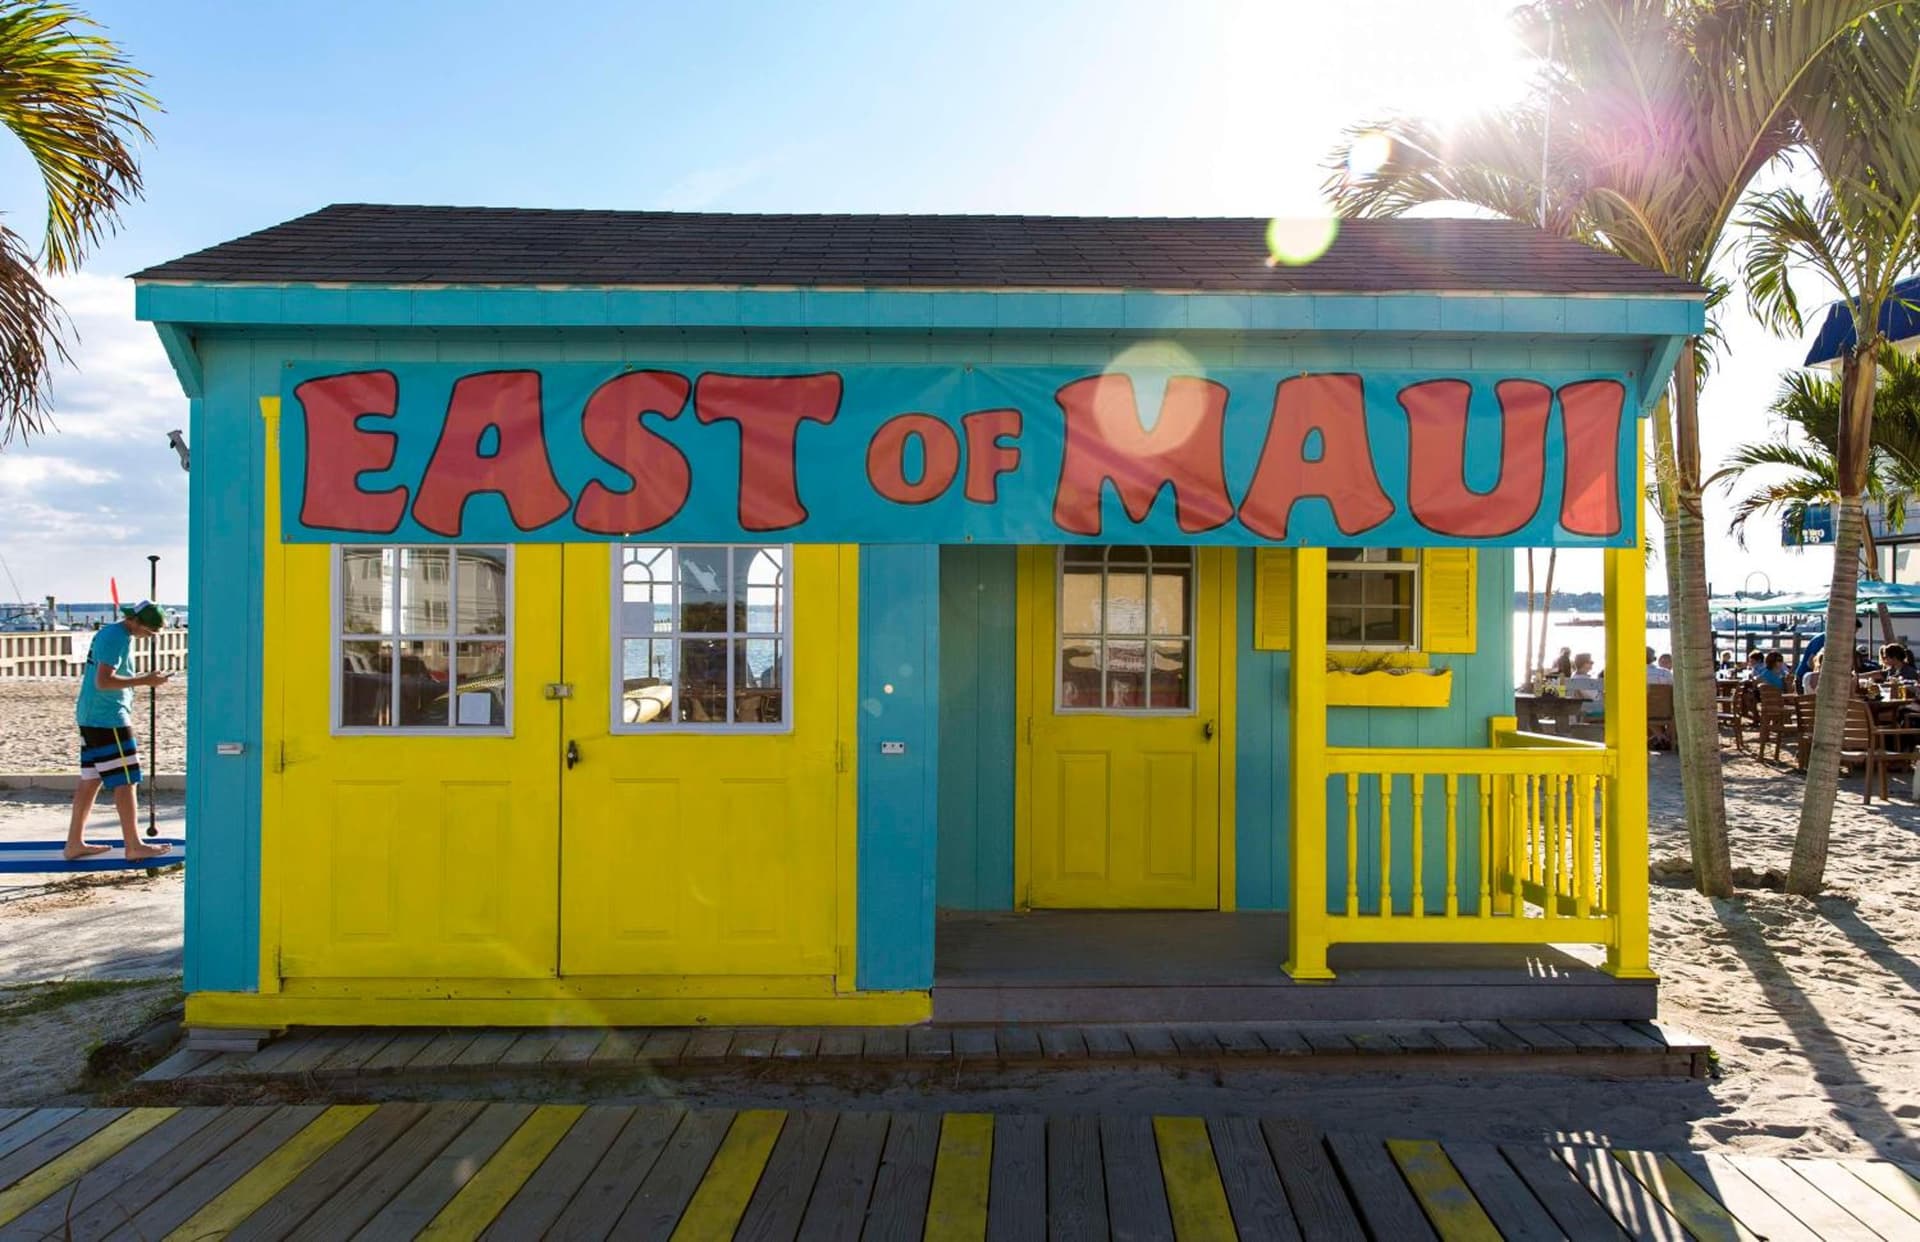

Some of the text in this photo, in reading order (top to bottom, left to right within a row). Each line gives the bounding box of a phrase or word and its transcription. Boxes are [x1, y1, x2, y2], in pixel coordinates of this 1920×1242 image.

[294, 369, 1625, 540] EAST OF MAUI
